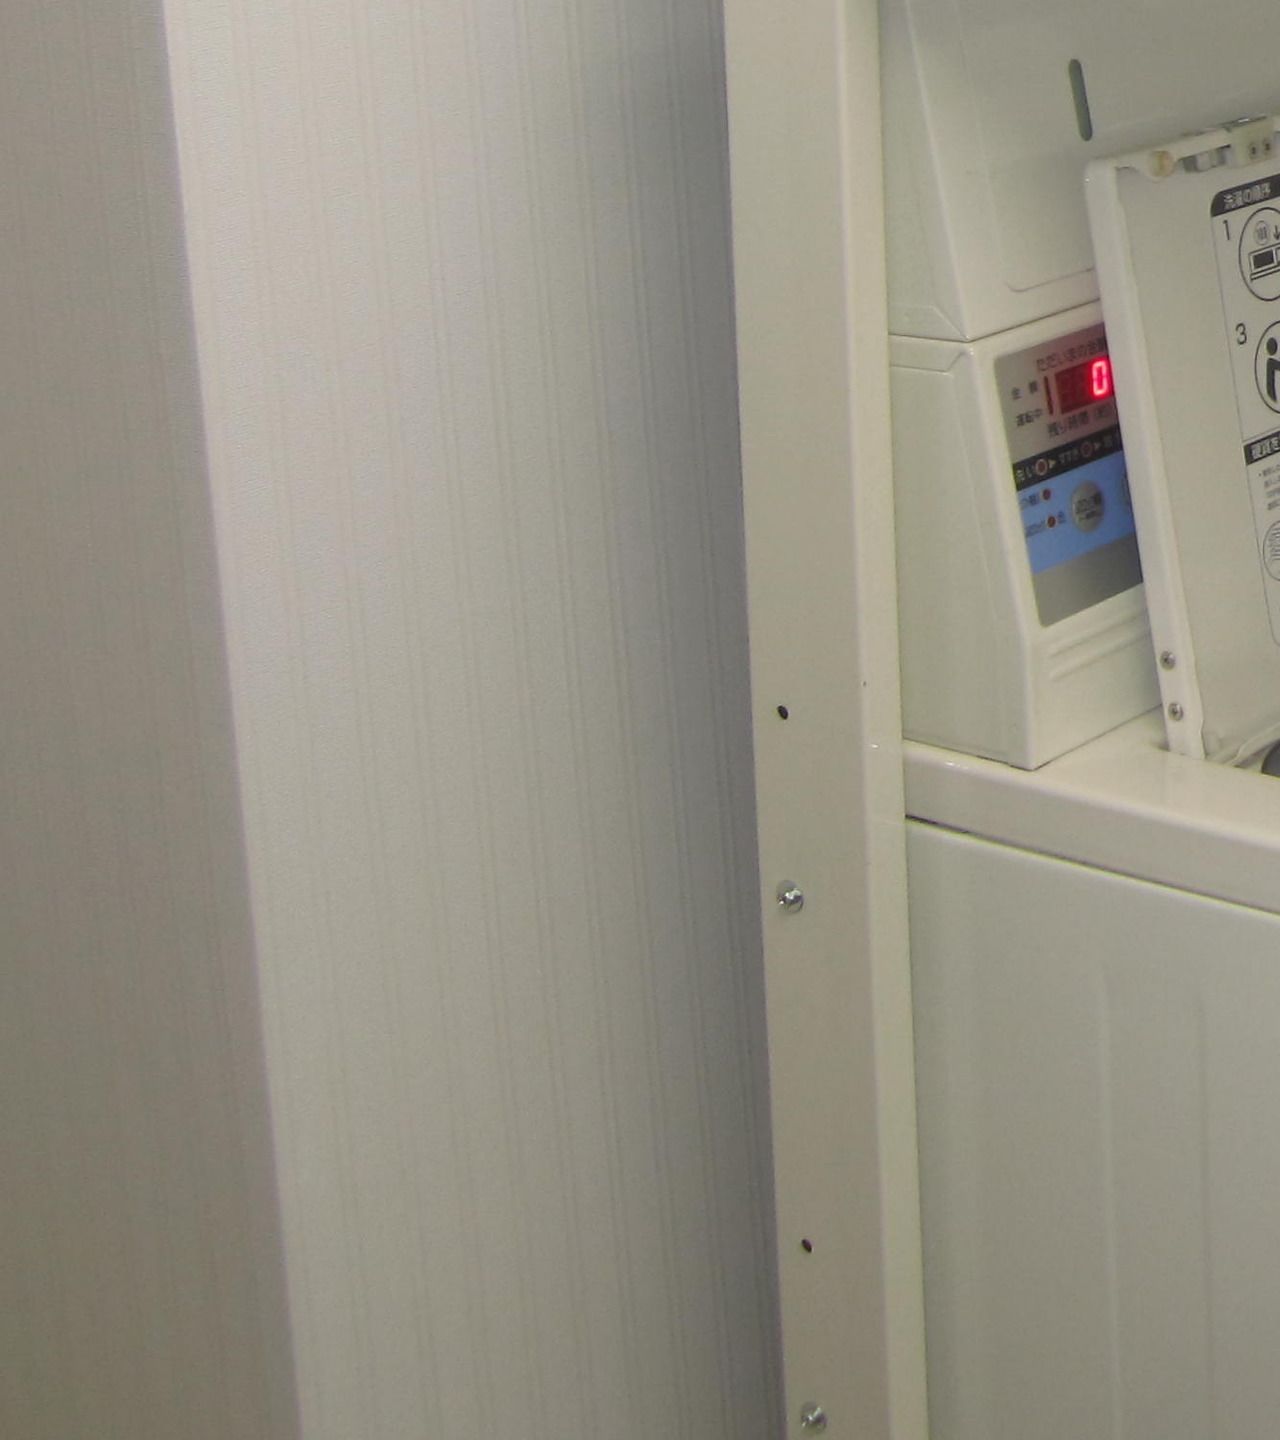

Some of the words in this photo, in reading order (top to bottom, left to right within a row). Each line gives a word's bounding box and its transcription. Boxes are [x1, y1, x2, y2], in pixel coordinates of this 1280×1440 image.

[1221, 219, 1231, 241] 1
[1235, 322, 1248, 346] 3
[1090, 359, 1109, 397] 0
[1015, 408, 1043, 427] 運転中
